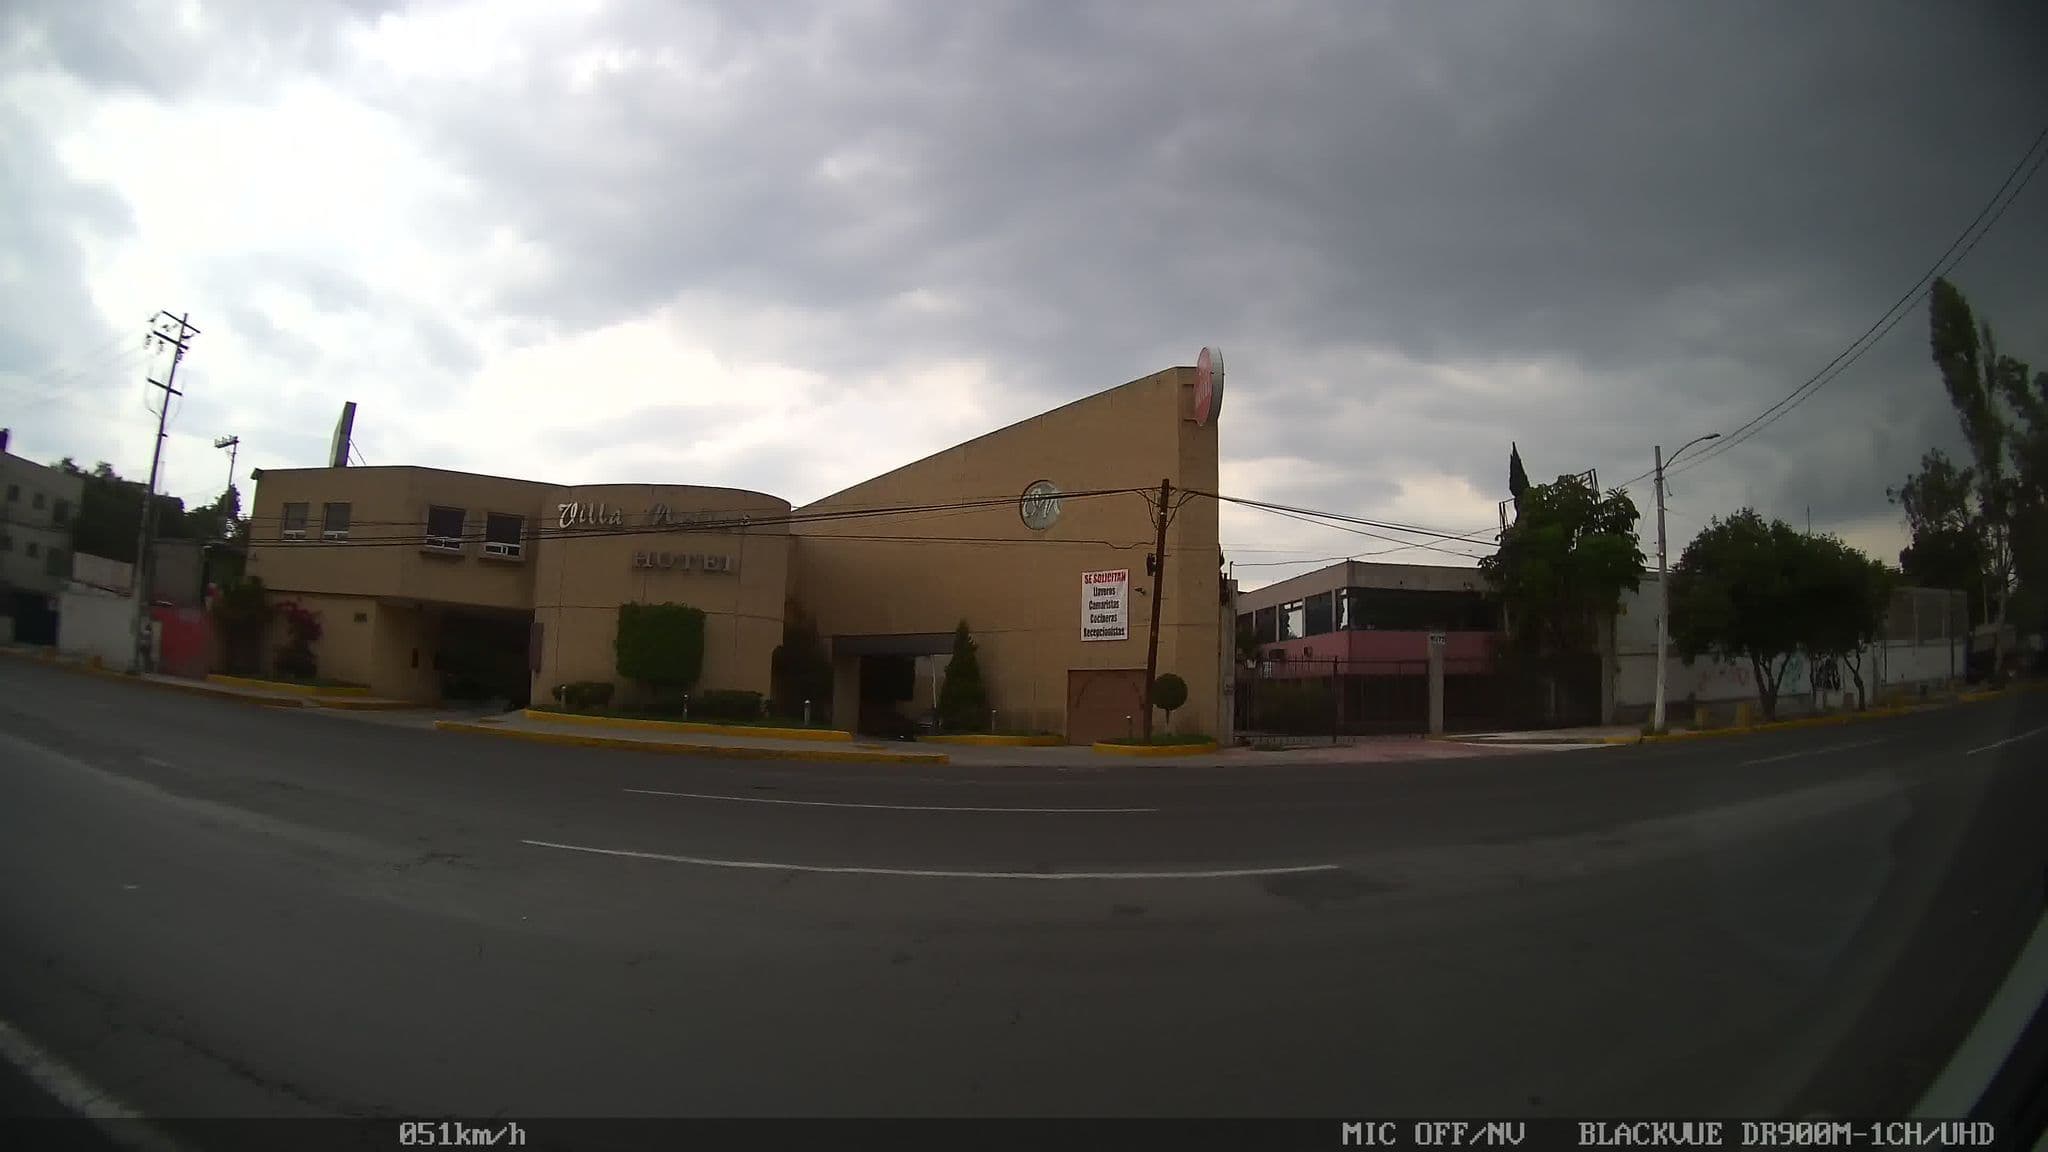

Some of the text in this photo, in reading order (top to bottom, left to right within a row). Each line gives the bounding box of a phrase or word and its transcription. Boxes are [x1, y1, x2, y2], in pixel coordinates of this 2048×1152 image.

[558, 502, 623, 529] Villa
[1085, 571, 1126, 584] SE SOLICITAN
[1089, 600, 1119, 610] Camaristas
[1083, 626, 1125, 637] Recepcionistas
